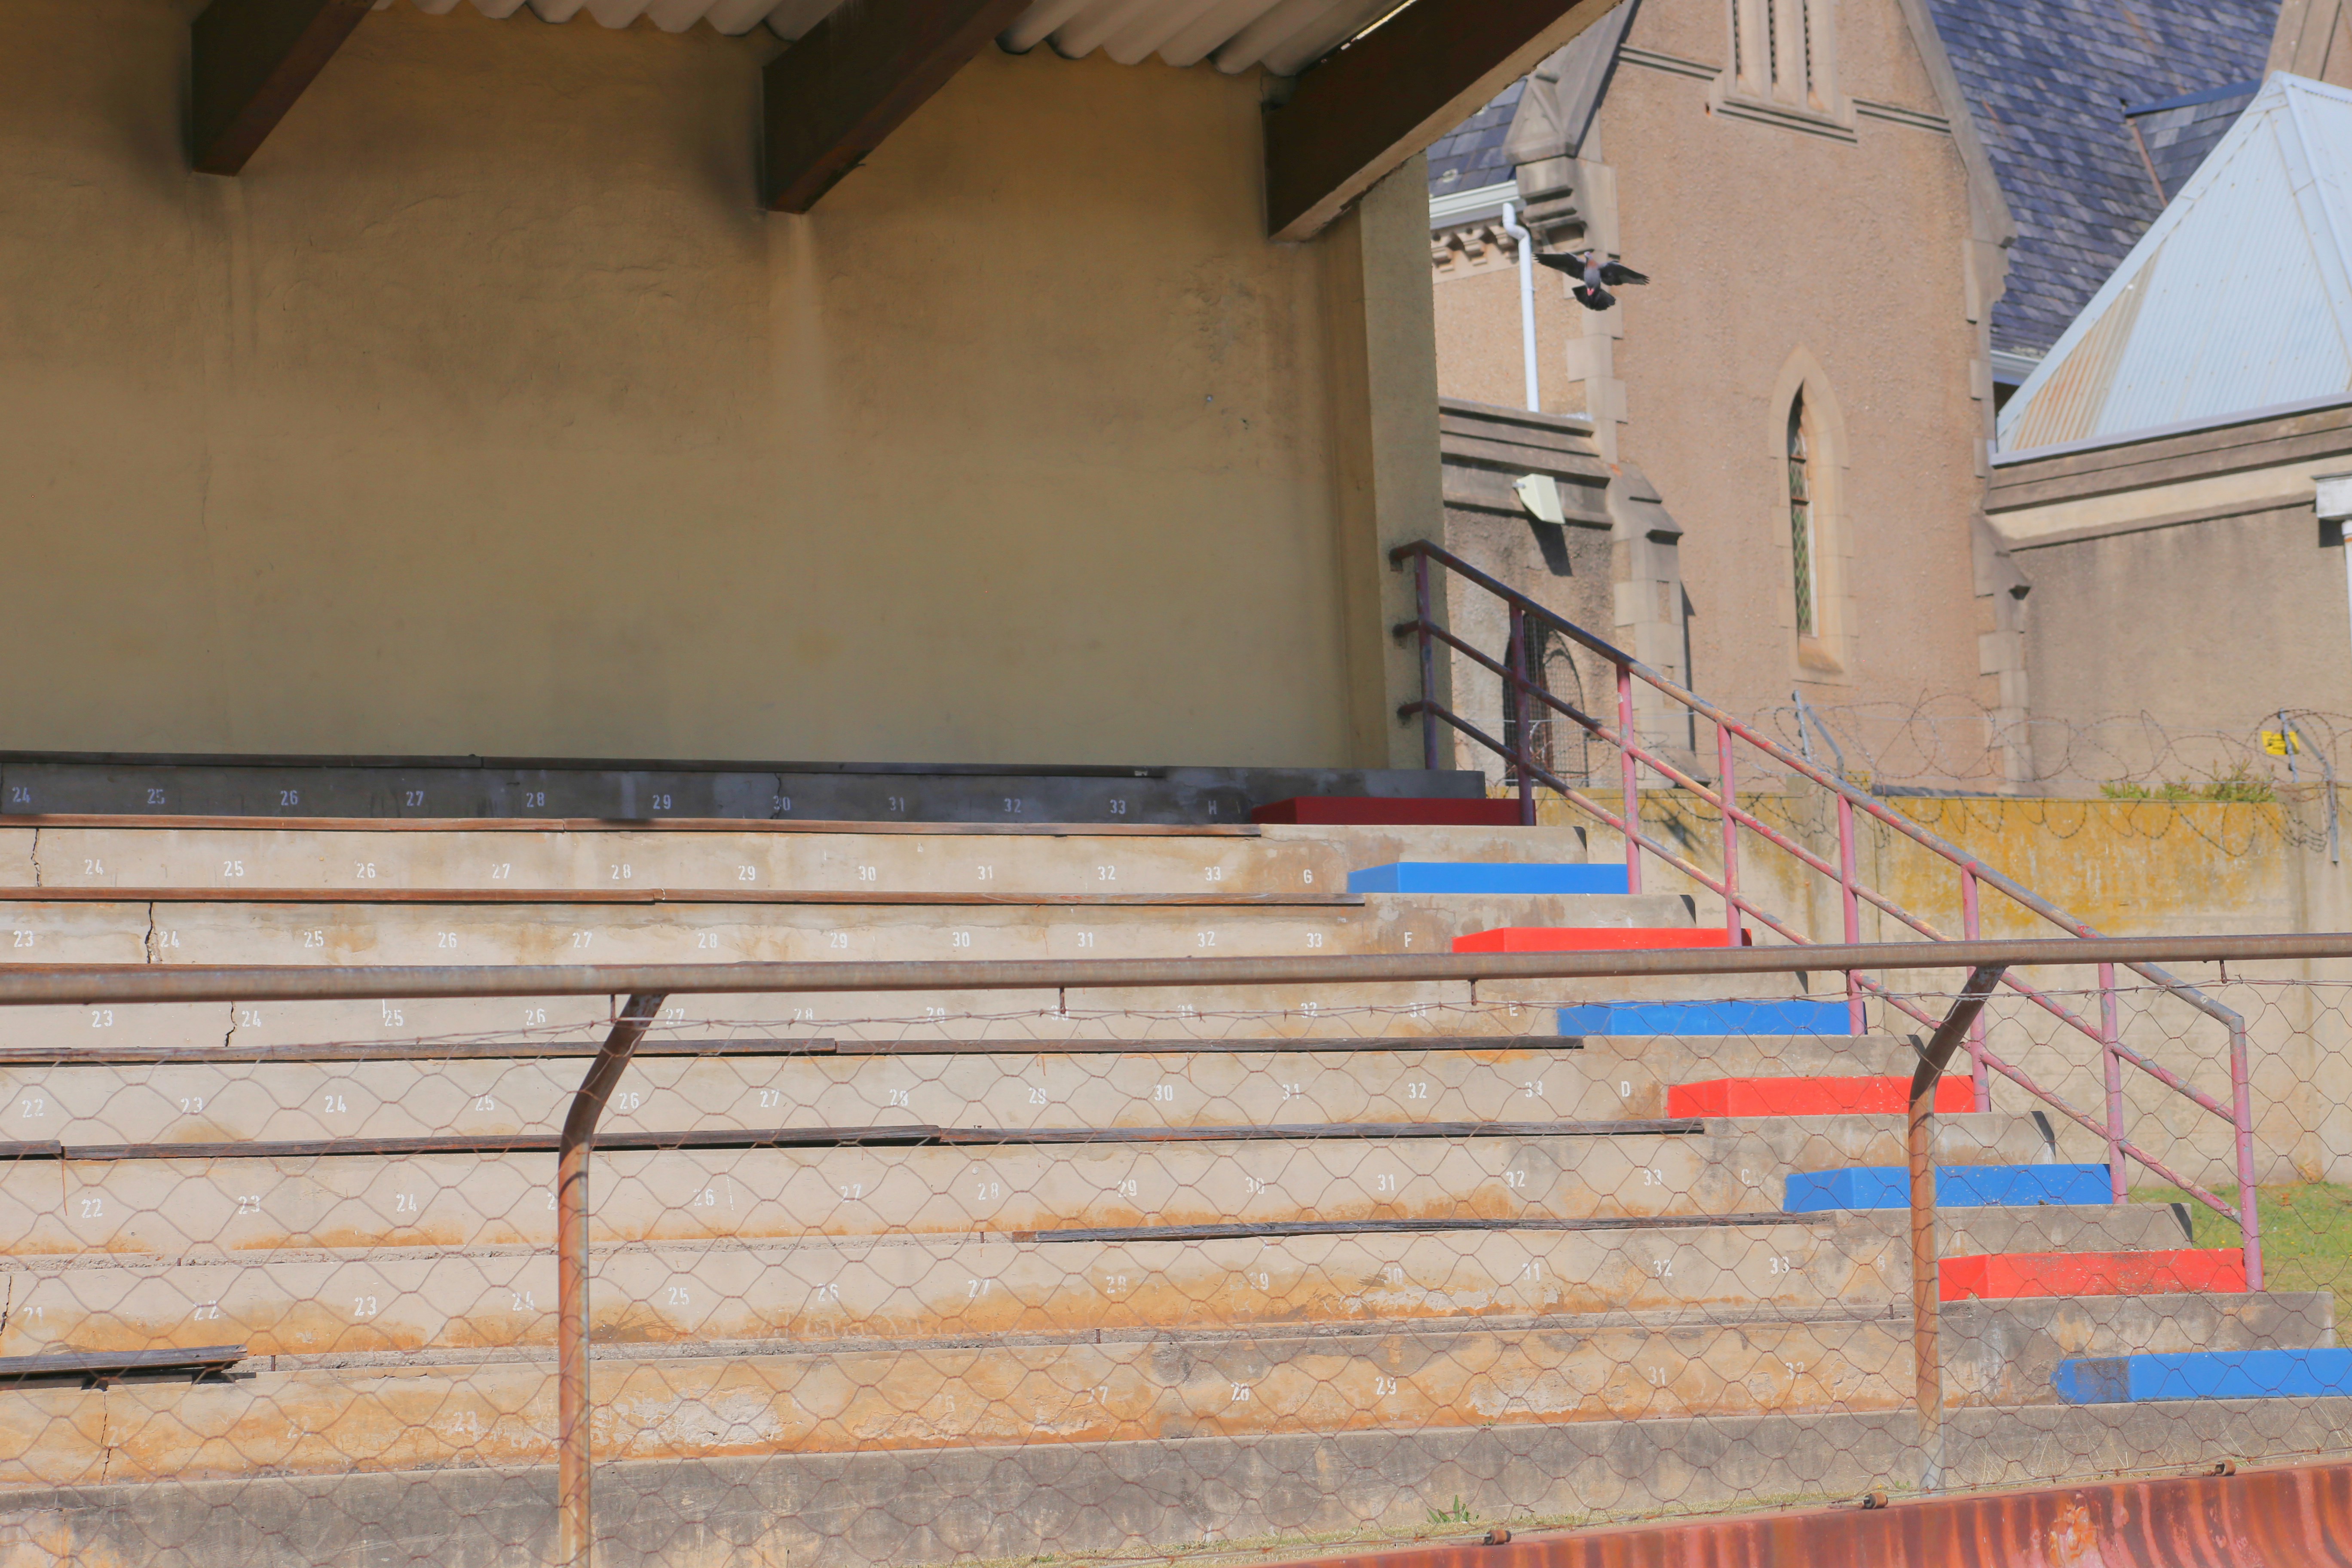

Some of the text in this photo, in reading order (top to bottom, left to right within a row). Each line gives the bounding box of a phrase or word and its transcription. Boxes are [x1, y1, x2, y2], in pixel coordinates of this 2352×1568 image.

[12, 787, 30, 803] 24
[148, 789, 165, 805] 25
[280, 790, 298, 806] 26
[406, 790, 423, 806] 27
[527, 792, 544, 808] 28
[653, 795, 671, 809] 29
[773, 795, 790, 811] 30
[889, 797, 904, 812] 31
[1004, 798, 1021, 813] 32
[1110, 799, 1126, 814] 33
[1208, 800, 1217, 815] H
[85, 860, 104, 875] 24
[224, 861, 243, 877] 25
[356, 863, 375, 878] 26
[493, 863, 511, 879] 27
[611, 864, 631, 880] 28
[738, 865, 756, 881] 29
[858, 866, 876, 881] 30
[978, 865, 993, 880] 31
[1098, 866, 1116, 880] 32
[1205, 867, 1221, 881] 33
[1303, 870, 1312, 884] G
[13, 931, 34, 947] 23
[159, 931, 179, 948] 24
[304, 931, 324, 948] 25
[438, 932, 457, 948] 26
[573, 931, 592, 948] 27
[698, 933, 718, 948] 28
[830, 933, 848, 949] 29
[952, 932, 970, 947] 30
[1078, 932, 1093, 947] 31
[1197, 931, 1215, 947] 32
[1307, 933, 1322, 948] 33
[1404, 932, 1412, 947] F
[525, 1009, 545, 1025] 26
[665, 1008, 685, 1024] 27
[794, 1008, 813, 1022] 28
[926, 1007, 945, 1023] 29
[1051, 1005, 1069, 1020] 30
[1178, 1004, 1194, 1020] 31
[1301, 1001, 1317, 1018] 32
[1409, 1002, 1426, 1018] 33
[1510, 1001, 1518, 1017] E
[92, 1011, 113, 1027] 23
[242, 1011, 261, 1027] 24
[385, 1010, 404, 1026] 25
[1029, 1087, 1046, 1104] 29
[1154, 1084, 1173, 1102] 30
[1282, 1084, 1299, 1100] 31
[1409, 1082, 1427, 1099] 32
[1525, 1081, 1543, 1097] 33
[1620, 1081, 1630, 1097] D
[180, 1097, 203, 1114] 23
[325, 1096, 346, 1113] 24
[475, 1093, 494, 1111] 25
[619, 1093, 639, 1109] 26
[760, 1090, 779, 1107] 27
[889, 1089, 908, 1106] 28
[22, 1099, 44, 1117] 22
[1378, 1174, 1394, 1191] 31
[1507, 1170, 1524, 1188] 32
[1643, 1169, 1661, 1185] 33
[1741, 1169, 1750, 1185] C
[840, 1184, 861, 1202] 27
[977, 1182, 998, 1200] 28
[1118, 1179, 1137, 1197] 29
[1246, 1177, 1265, 1195] 30
[238, 1195, 260, 1214] 23
[396, 1194, 417, 1211] 24
[693, 1189, 714, 1206] 26
[82, 1199, 103, 1218] 22
[1522, 1263, 1540, 1281] 31
[1654, 1259, 1672, 1277] 32
[1769, 1257, 1789, 1274] 33
[1249, 1272, 1269, 1290] 29
[1383, 1267, 1403, 1284] 30
[818, 1283, 838, 1302] 26
[968, 1278, 989, 1297] 27
[512, 1292, 534, 1311] 24
[668, 1287, 689, 1306] 25
[194, 1301, 218, 1320] 22
[355, 1296, 376, 1316] 23
[1648, 1366, 1665, 1384] 31
[1376, 1377, 1397, 1395] 29
